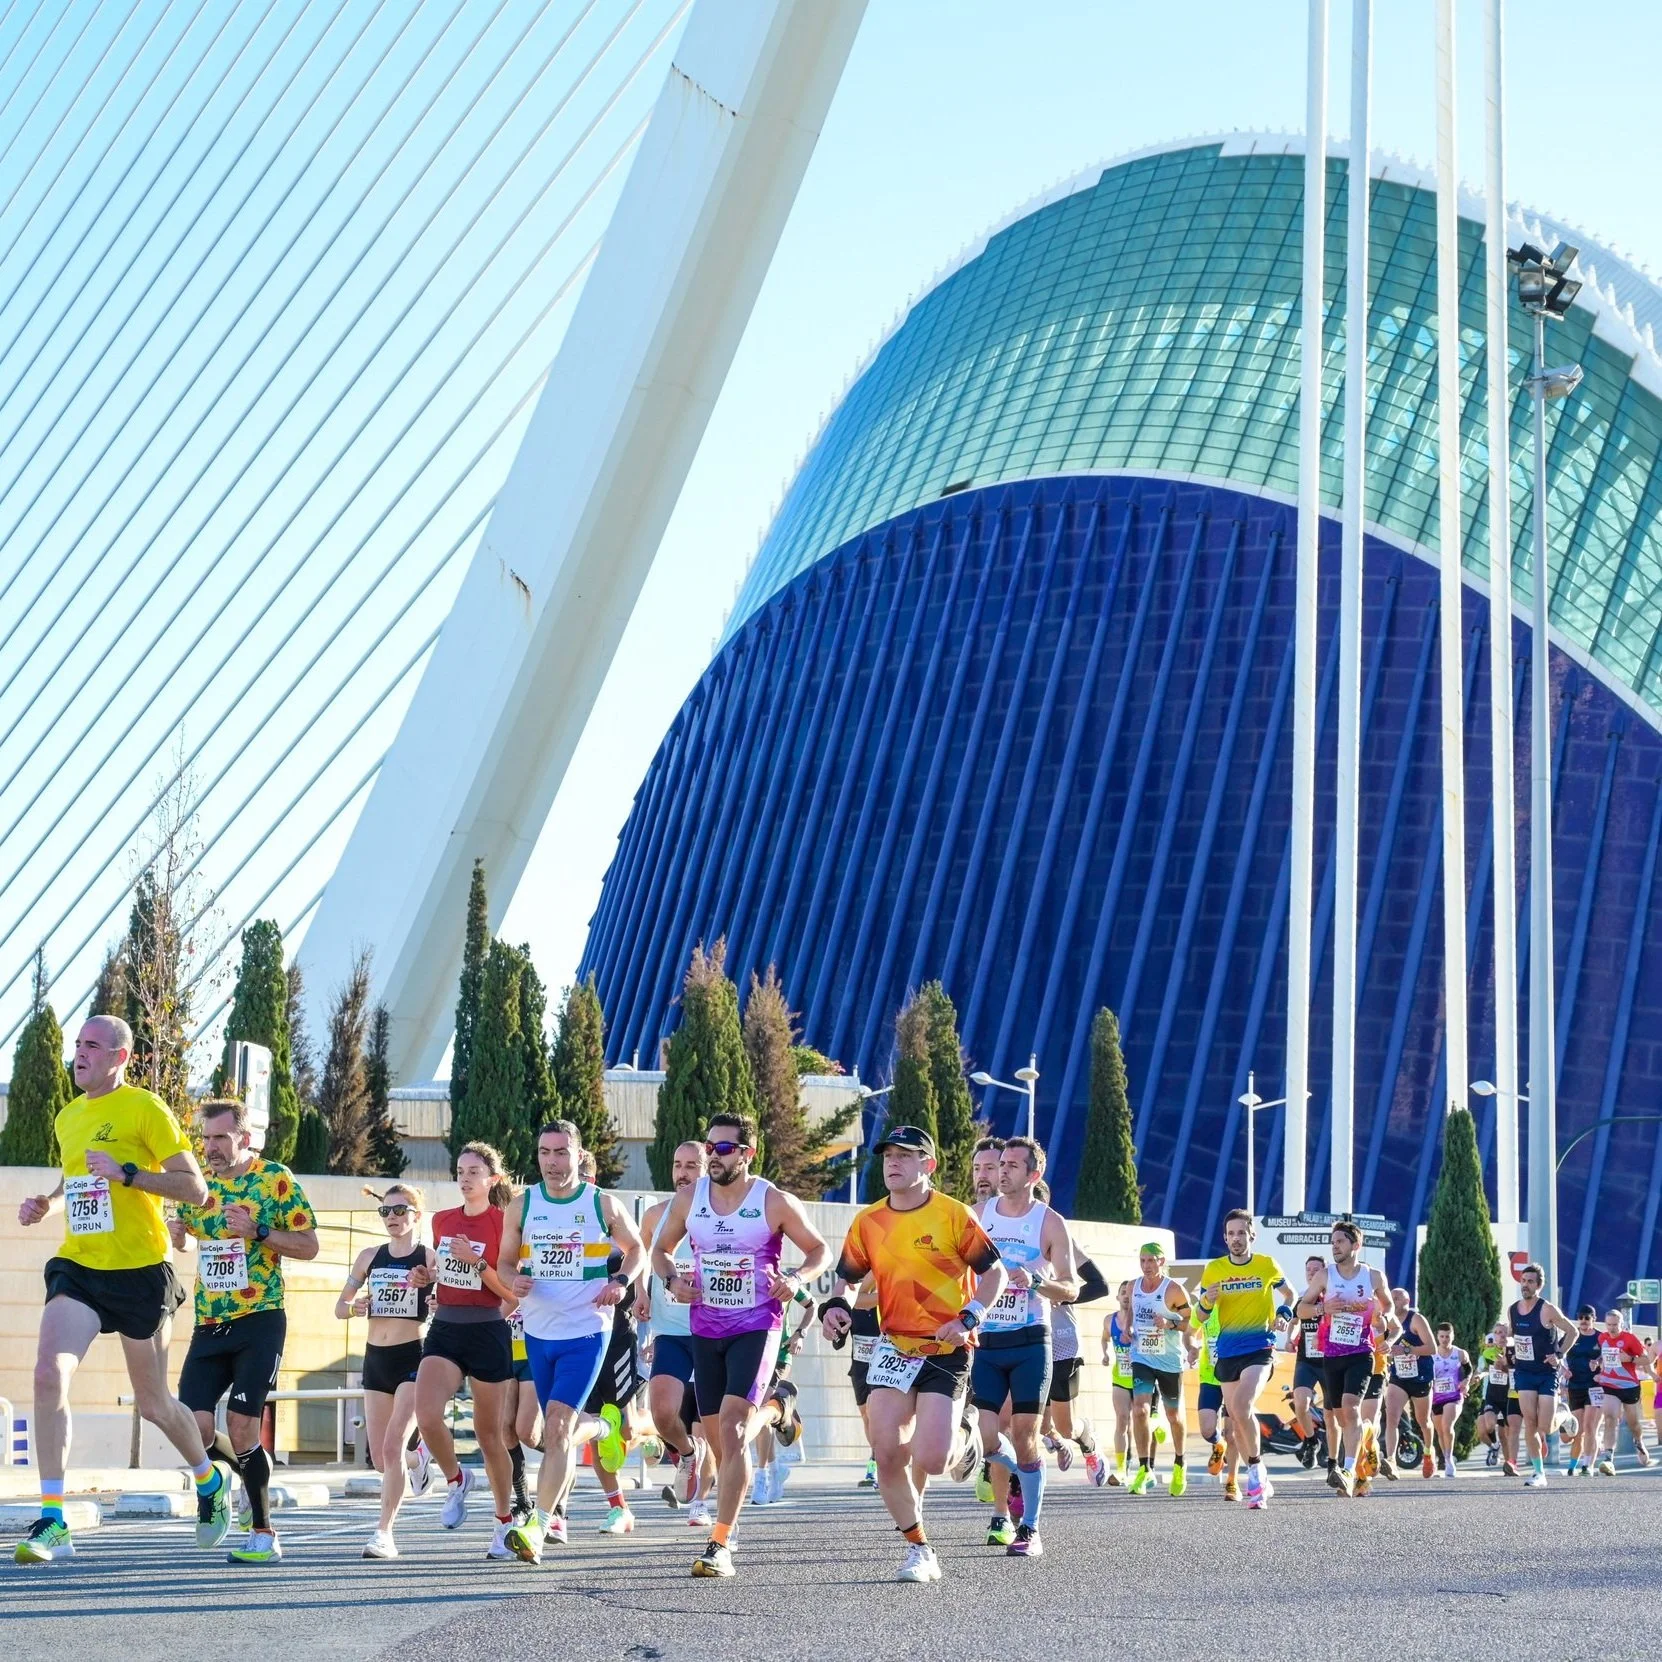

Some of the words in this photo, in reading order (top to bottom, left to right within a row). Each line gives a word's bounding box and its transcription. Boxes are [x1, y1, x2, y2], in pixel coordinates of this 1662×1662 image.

[72, 1199, 98, 1217] 2758
[73, 1222, 101, 1231] KIPRUN
[1268, 1218, 1291, 1227] MUSEU
[531, 1233, 563, 1241] iberCaja
[1284, 1235, 1320, 1243] UMBRACLE
[541, 1250, 573, 1264] 3220
[207, 1261, 235, 1276] 2708
[445, 1258, 470, 1274] 2290
[207, 1281, 237, 1289] KIPRUN
[444, 1276, 471, 1287] KIPRUN
[710, 1277, 743, 1292] 2680
[1221, 1281, 1262, 1291] runners
[378, 1289, 407, 1302] 2567
[710, 1297, 744, 1306] KIPRUN
[993, 1295, 1016, 1309] 619
[987, 1313, 1017, 1321] KIPRUN
[1337, 1326, 1355, 1336] 2655
[1142, 1338, 1159, 1347] 2600
[878, 1355, 907, 1373] 2825
[873, 1374, 901, 1385] KIPRUN
